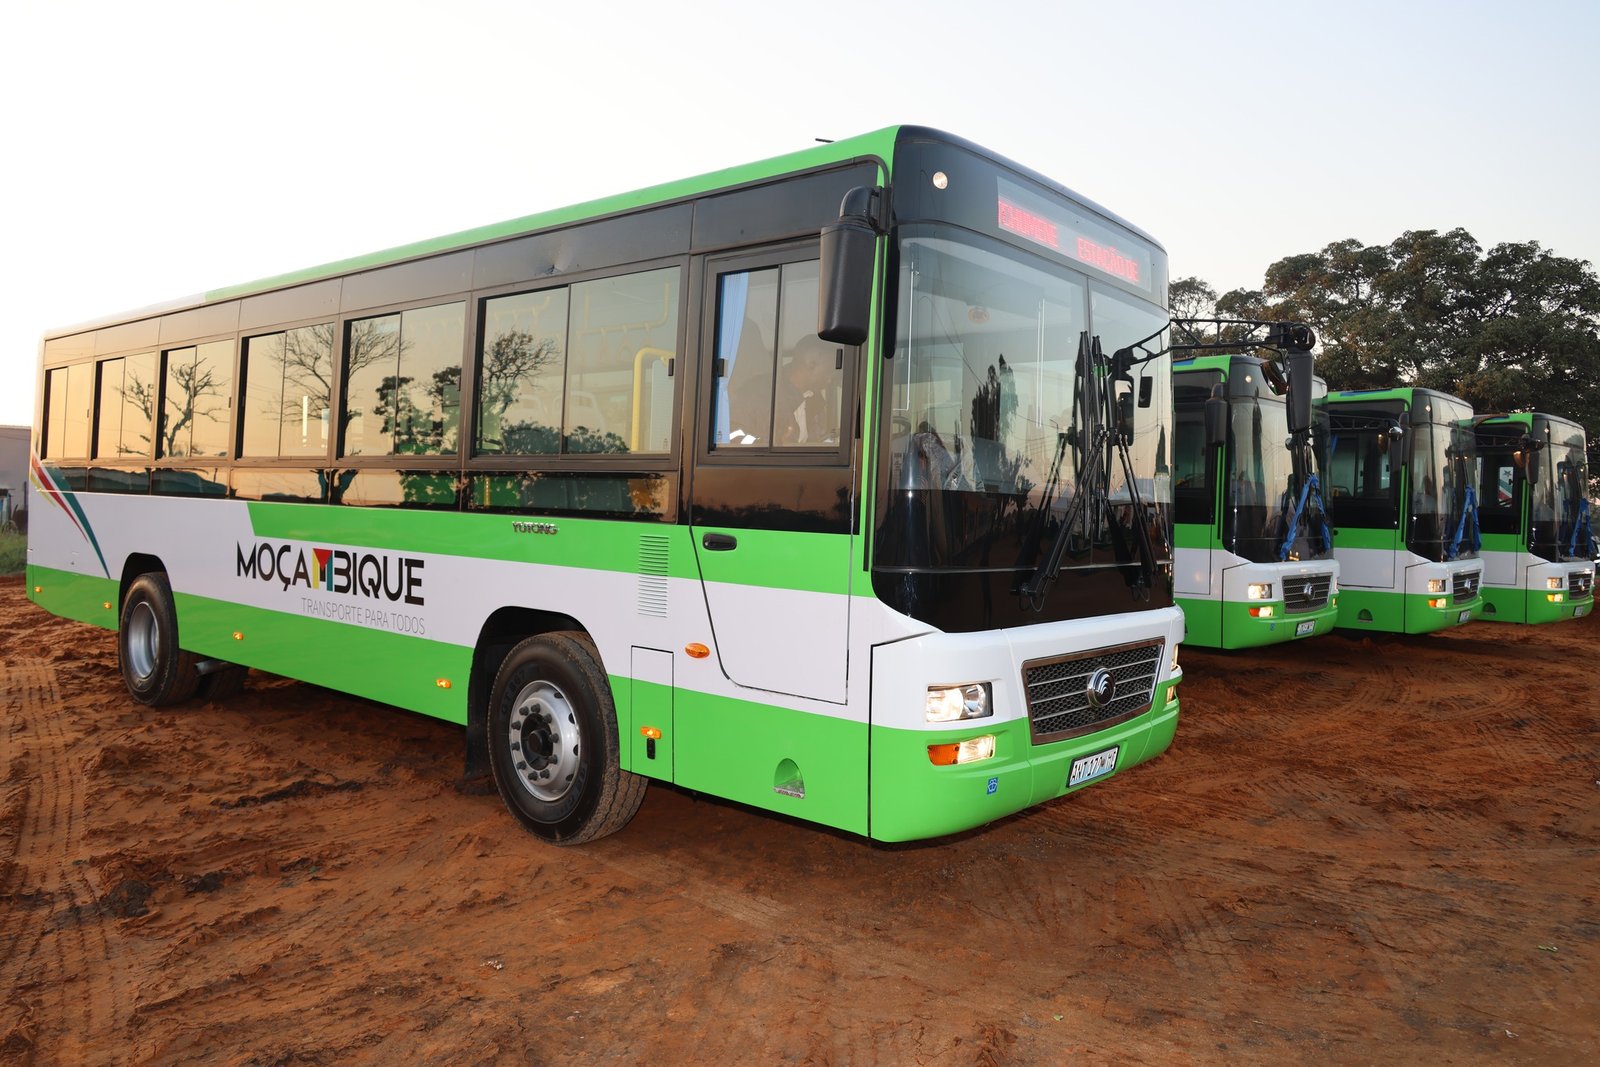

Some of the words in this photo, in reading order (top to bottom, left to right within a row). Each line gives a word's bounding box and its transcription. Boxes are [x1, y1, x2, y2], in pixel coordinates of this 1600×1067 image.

[237, 541, 425, 606] MOÇAMBIQUE
[301, 597, 363, 624] TRANSPORTE
[365, 608, 389, 629] PARA
[391, 612, 425, 635] TODOS
